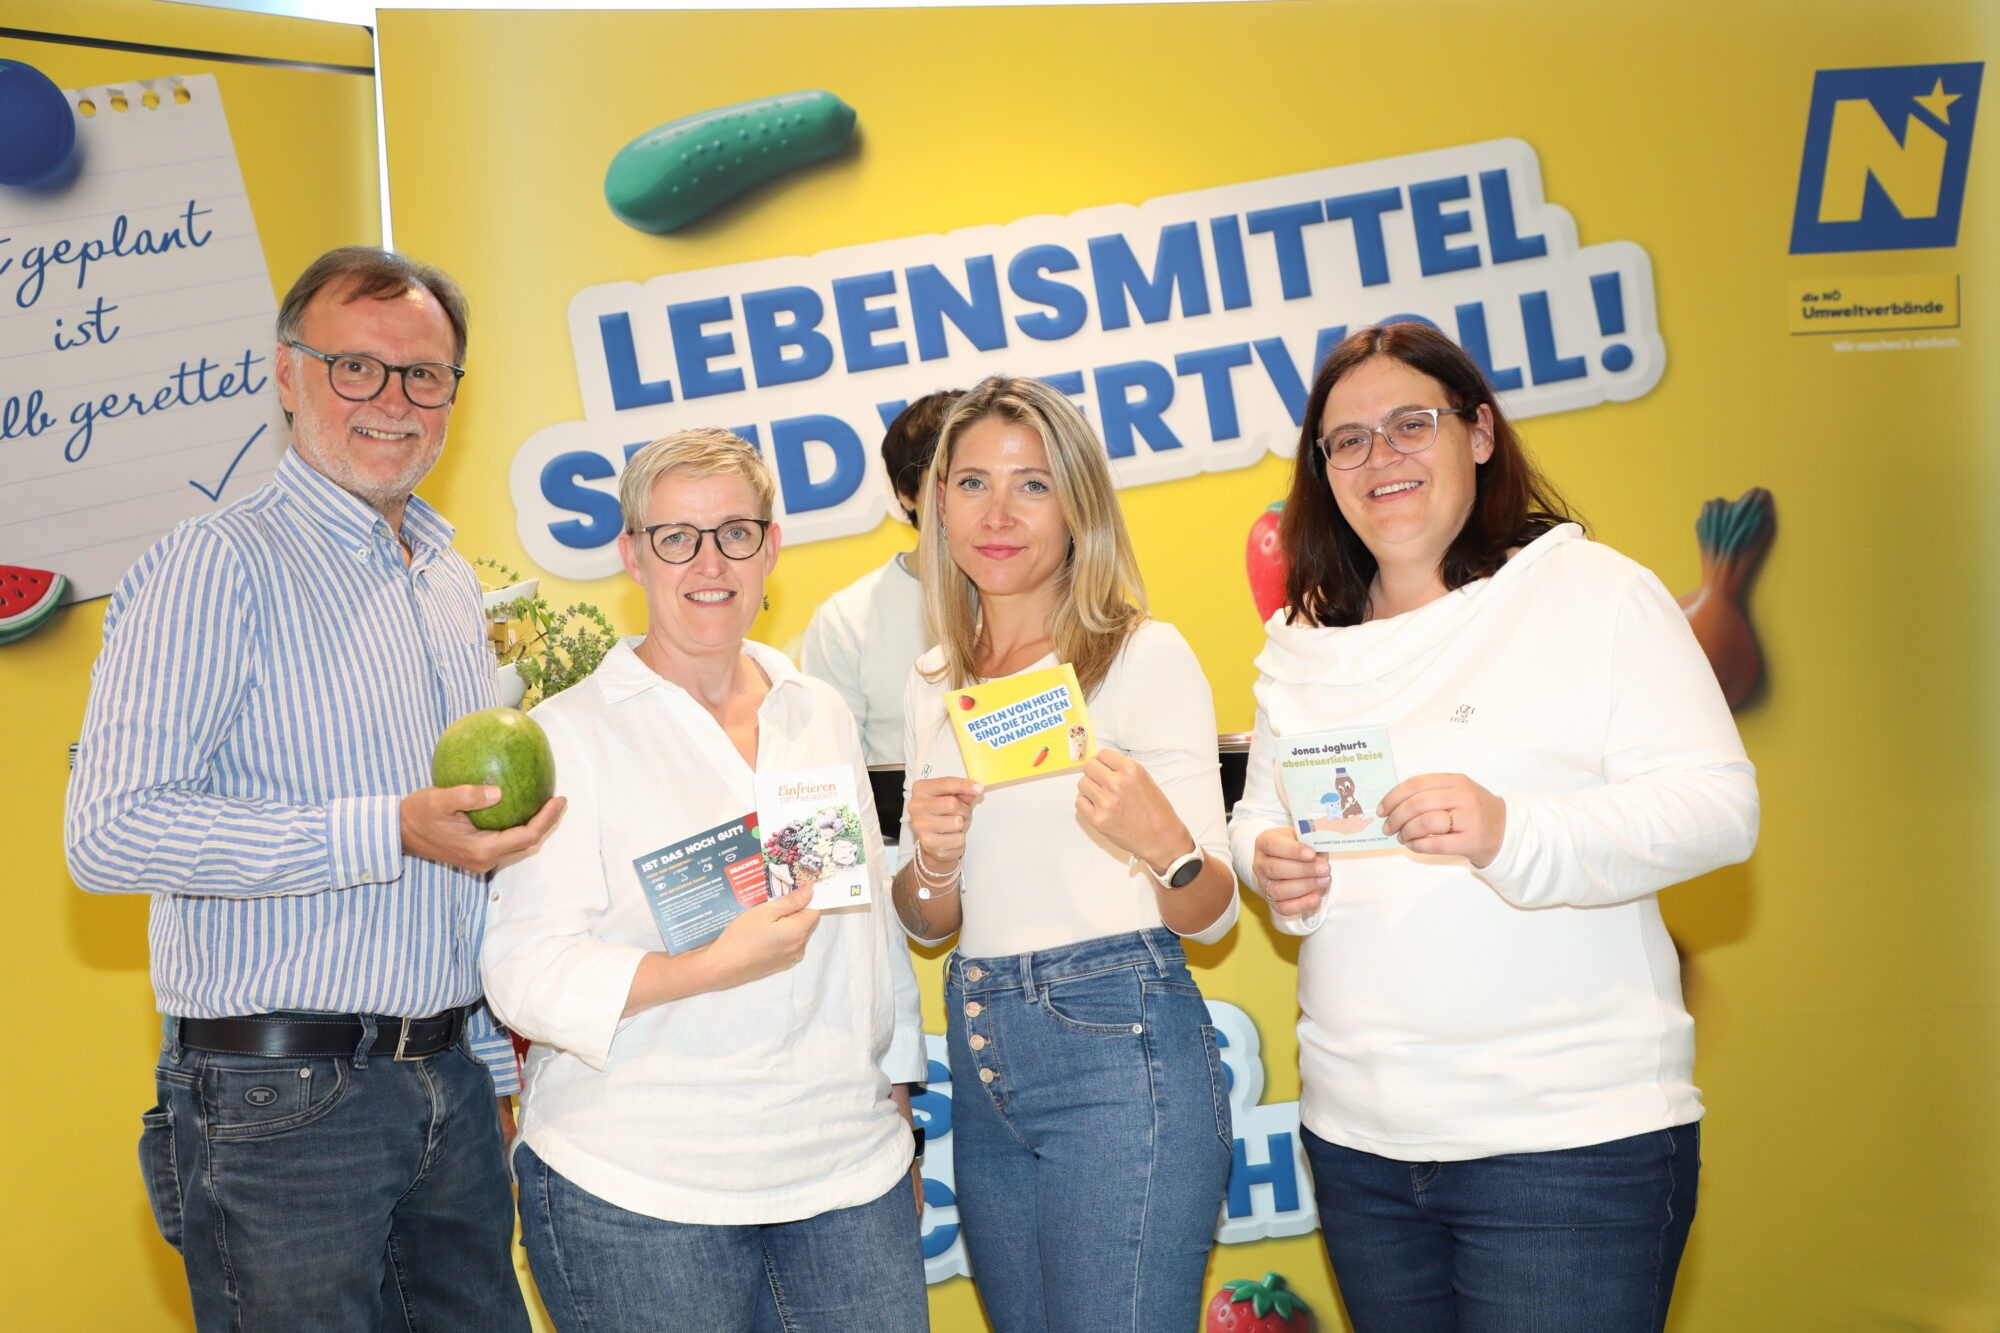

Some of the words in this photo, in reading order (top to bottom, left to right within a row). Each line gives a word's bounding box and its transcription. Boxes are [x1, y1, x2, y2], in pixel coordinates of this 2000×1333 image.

[16, 199, 213, 308] geplant
[598, 168, 1548, 412] LEBENSMITTEL
[1802, 301, 1944, 319] Umweltverbände
[54, 296, 120, 351] ist
[64, 350, 268, 462] gerettet
[540, 414, 866, 550] SD
[876, 271, 1634, 459] RTVLL!
[967, 709, 1007, 733] RESTLN
[1007, 700, 1033, 718] VON
[1032, 687, 1068, 708] HEUTE
[975, 726, 1001, 742] SIND
[1002, 718, 1020, 732] DIE
[1020, 698, 1070, 725] ZUTATEN
[990, 732, 1015, 748] VON
[1016, 714, 1063, 739] MORGEN
[1282, 754, 1355, 768] abenteuerliche
[1356, 751, 1384, 762] Reise
[1292, 747, 1320, 756] Jonas
[1322, 740, 1367, 754] Joghurts
[778, 782, 836, 799] Einfrieren
[641, 859, 659, 873] IST
[661, 849, 684, 865] DAS
[685, 836, 716, 855] NOCH
[718, 824, 744, 841] GUT?
